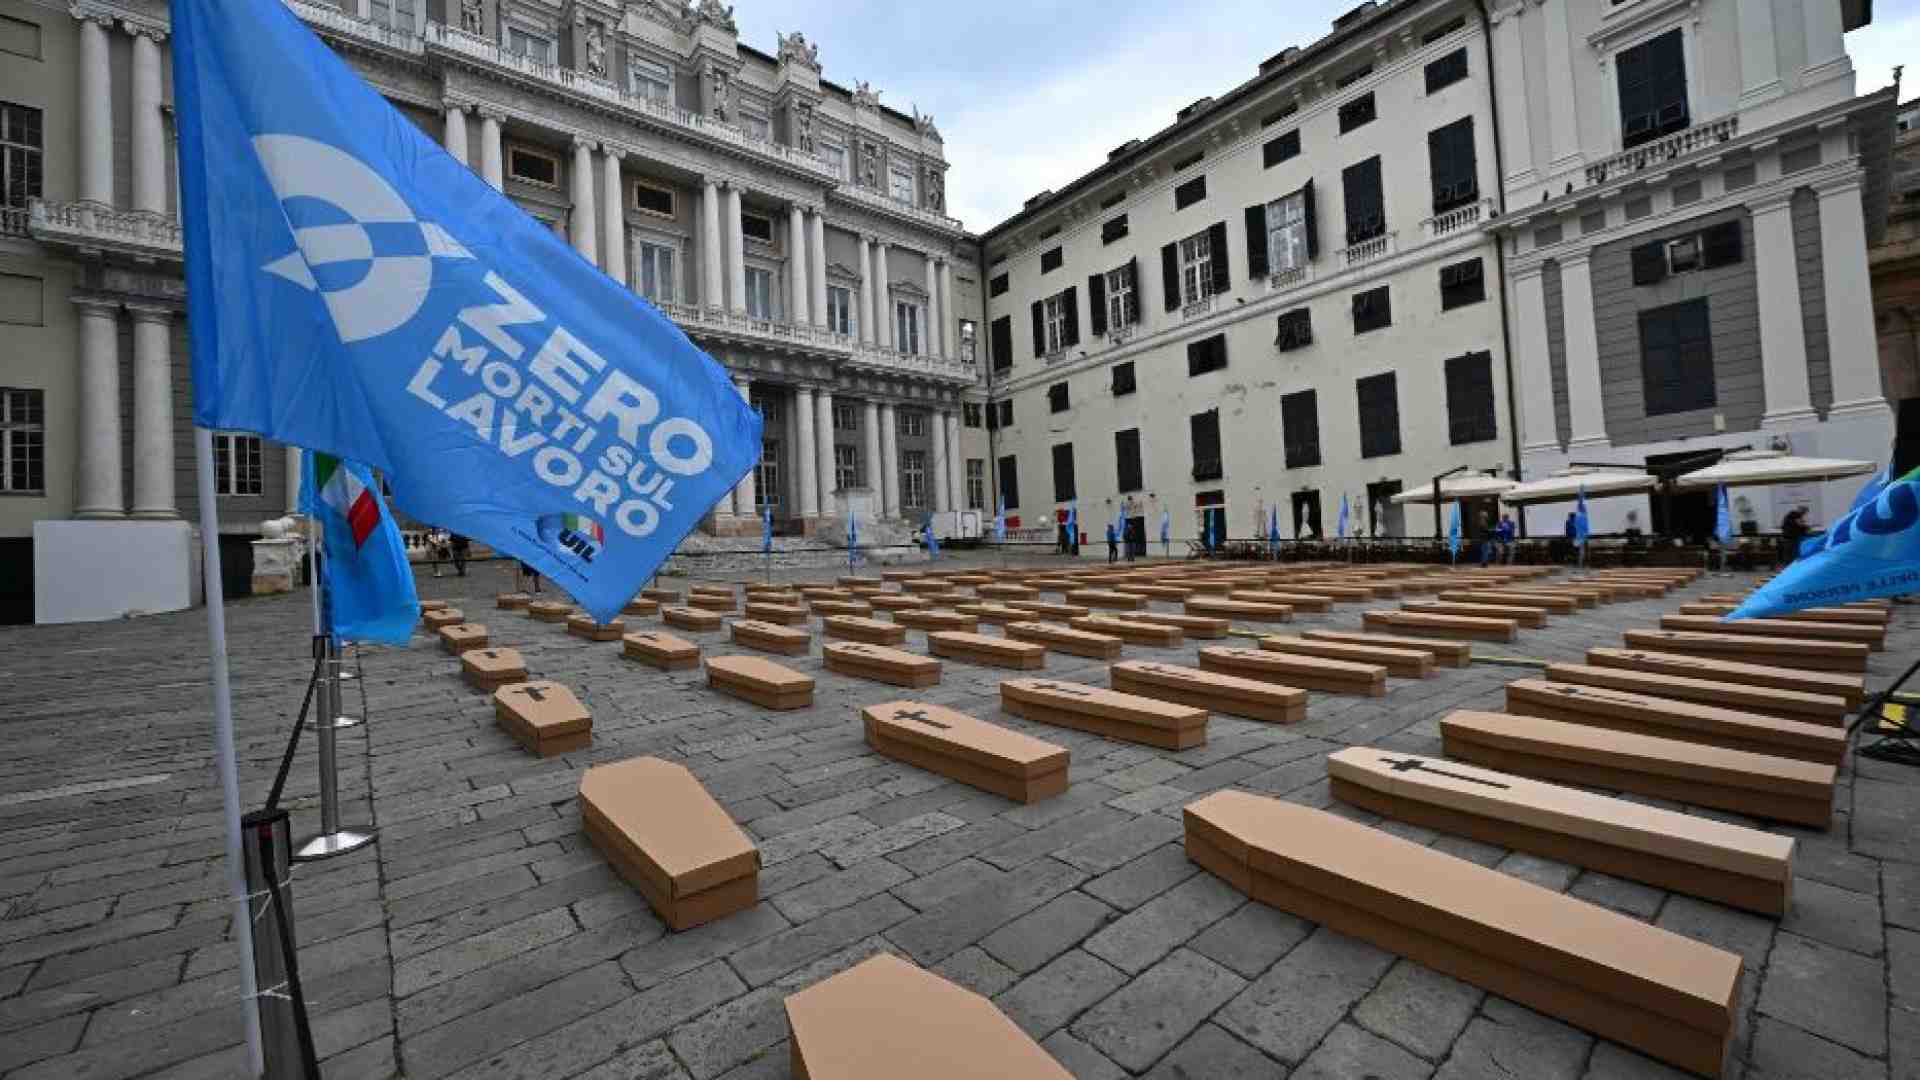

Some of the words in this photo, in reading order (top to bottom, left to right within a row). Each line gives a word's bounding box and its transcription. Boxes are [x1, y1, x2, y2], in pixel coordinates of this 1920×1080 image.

[406, 357, 660, 536] LAVORO
[433, 326, 597, 453] MORTI
[599, 445, 675, 511] SUL
[457, 270, 712, 475] ZERO
[559, 528, 596, 562] UIL
